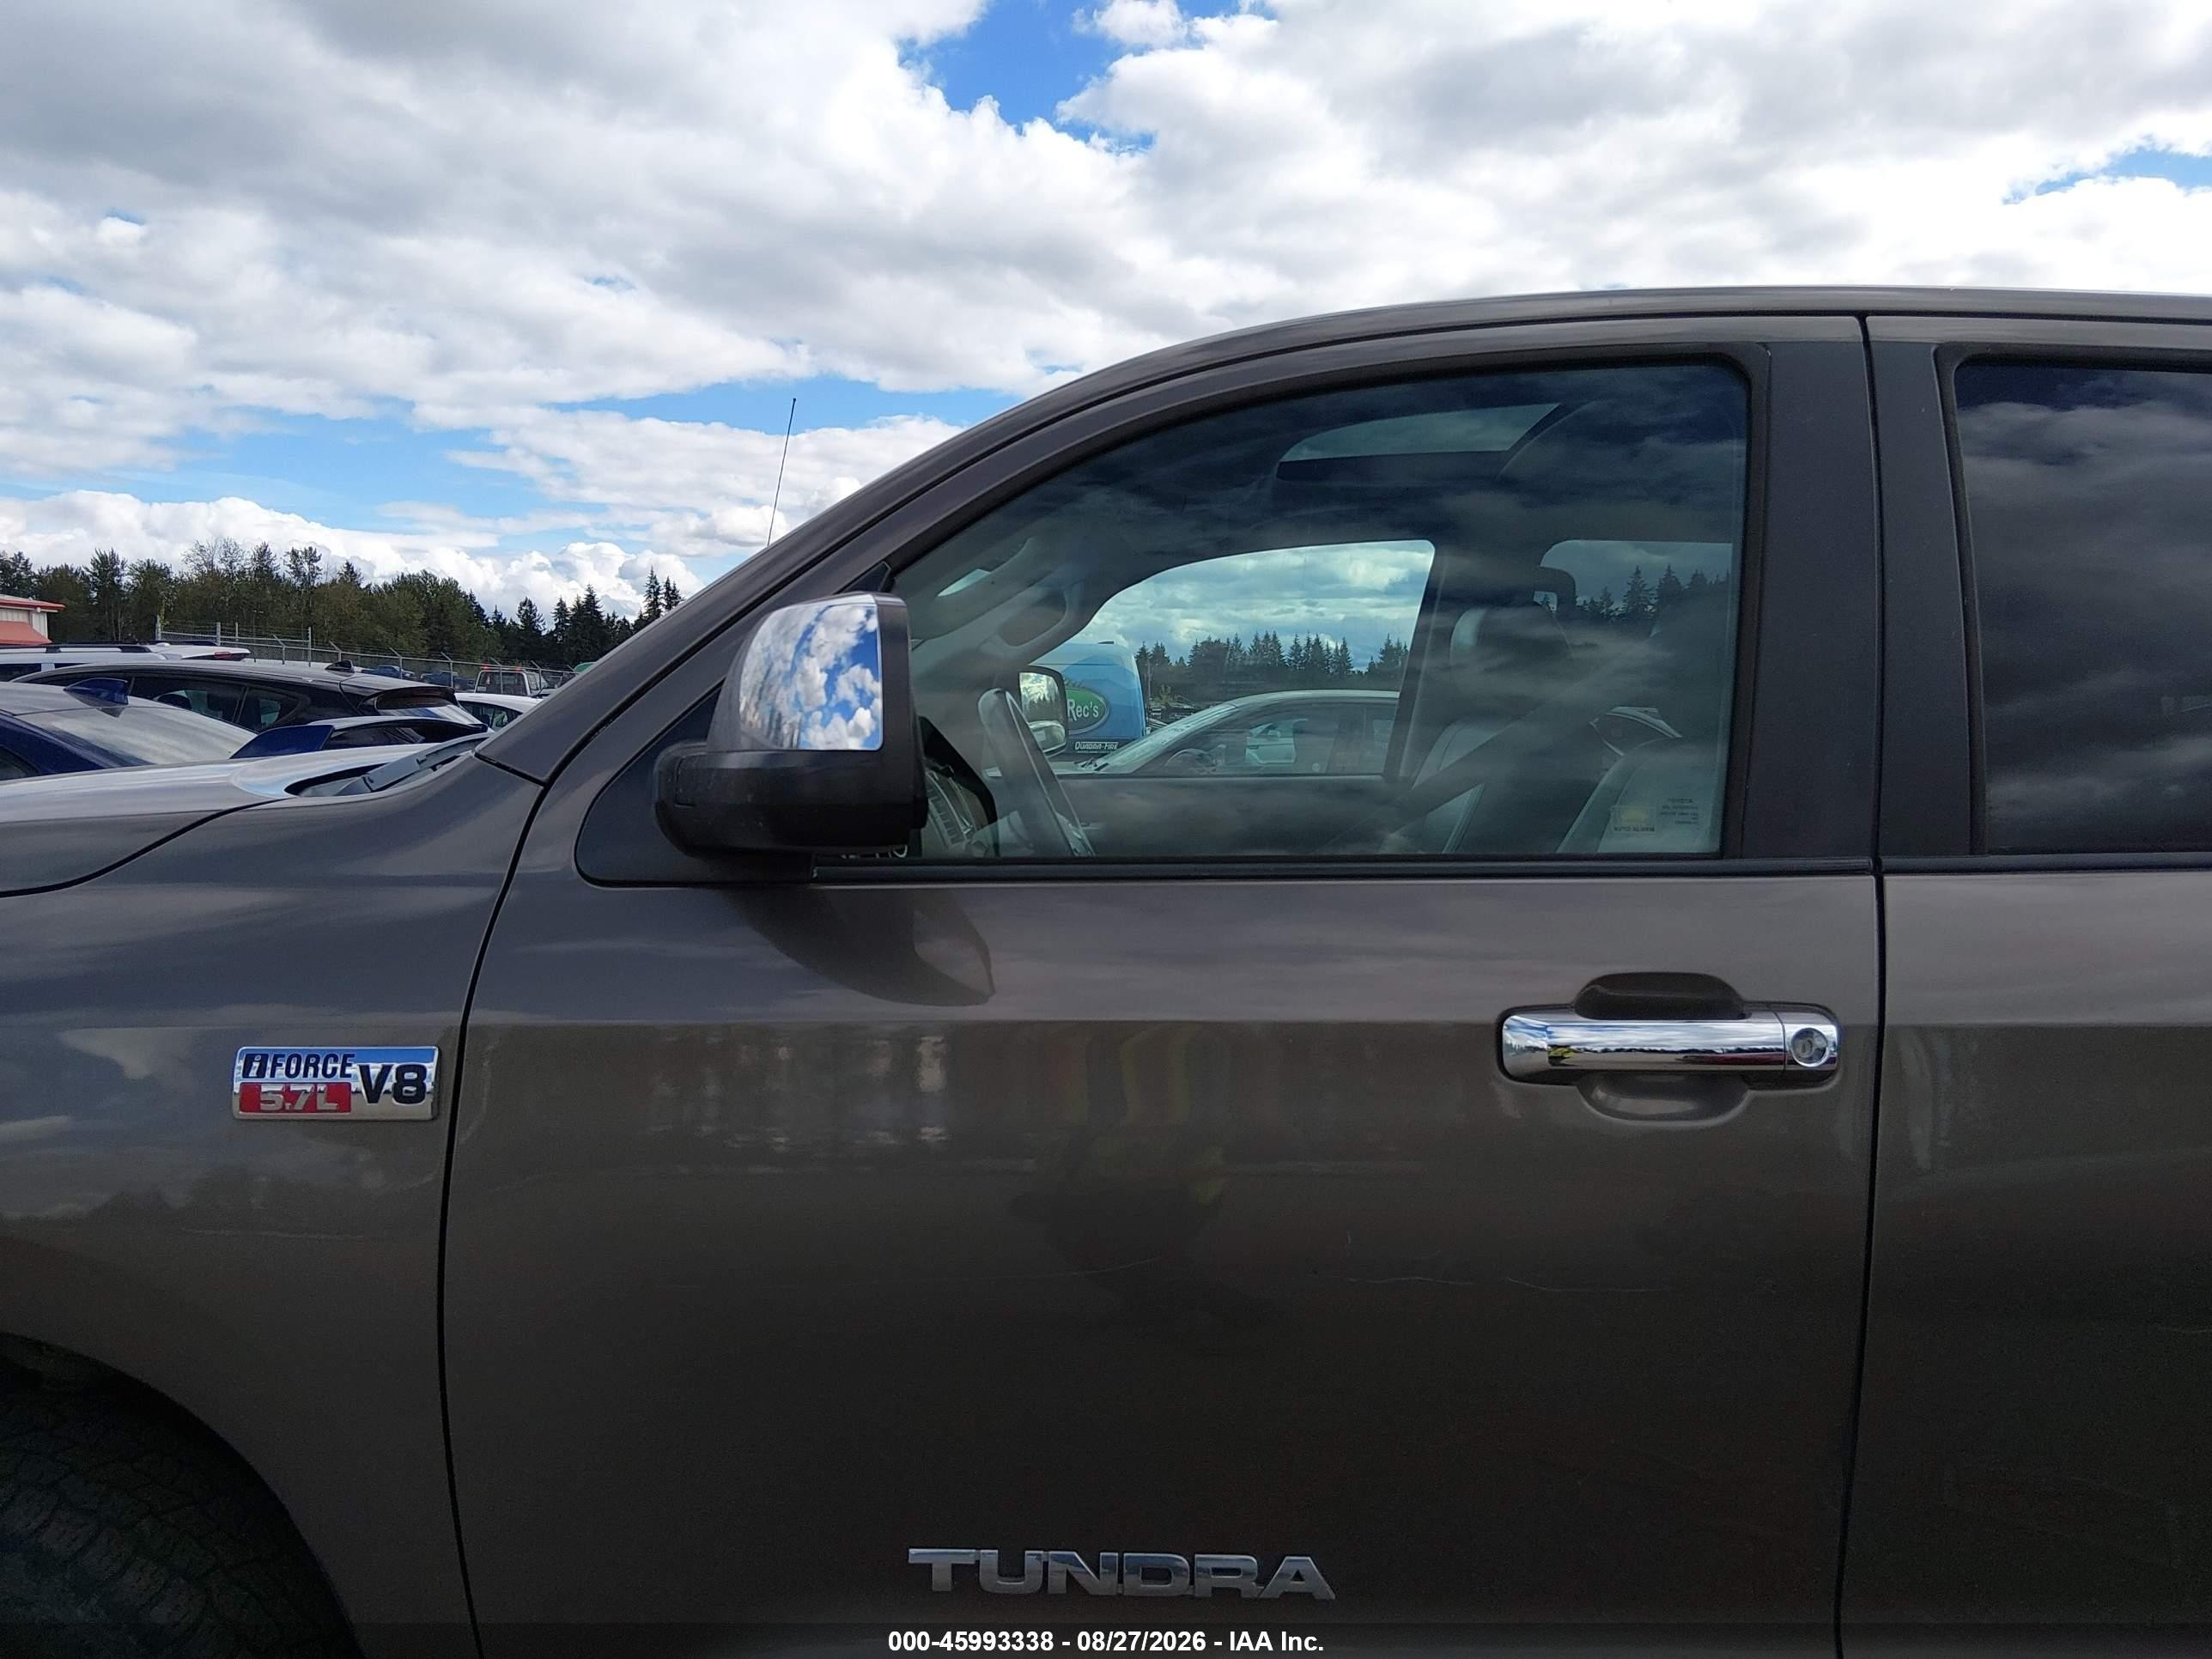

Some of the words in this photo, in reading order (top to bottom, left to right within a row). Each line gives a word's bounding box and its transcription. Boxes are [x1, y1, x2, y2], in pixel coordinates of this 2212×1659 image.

[259, 1084, 339, 1112] 5.7L
[357, 1063, 428, 1105] V8
[908, 1548, 1336, 1601] TUNDRA
